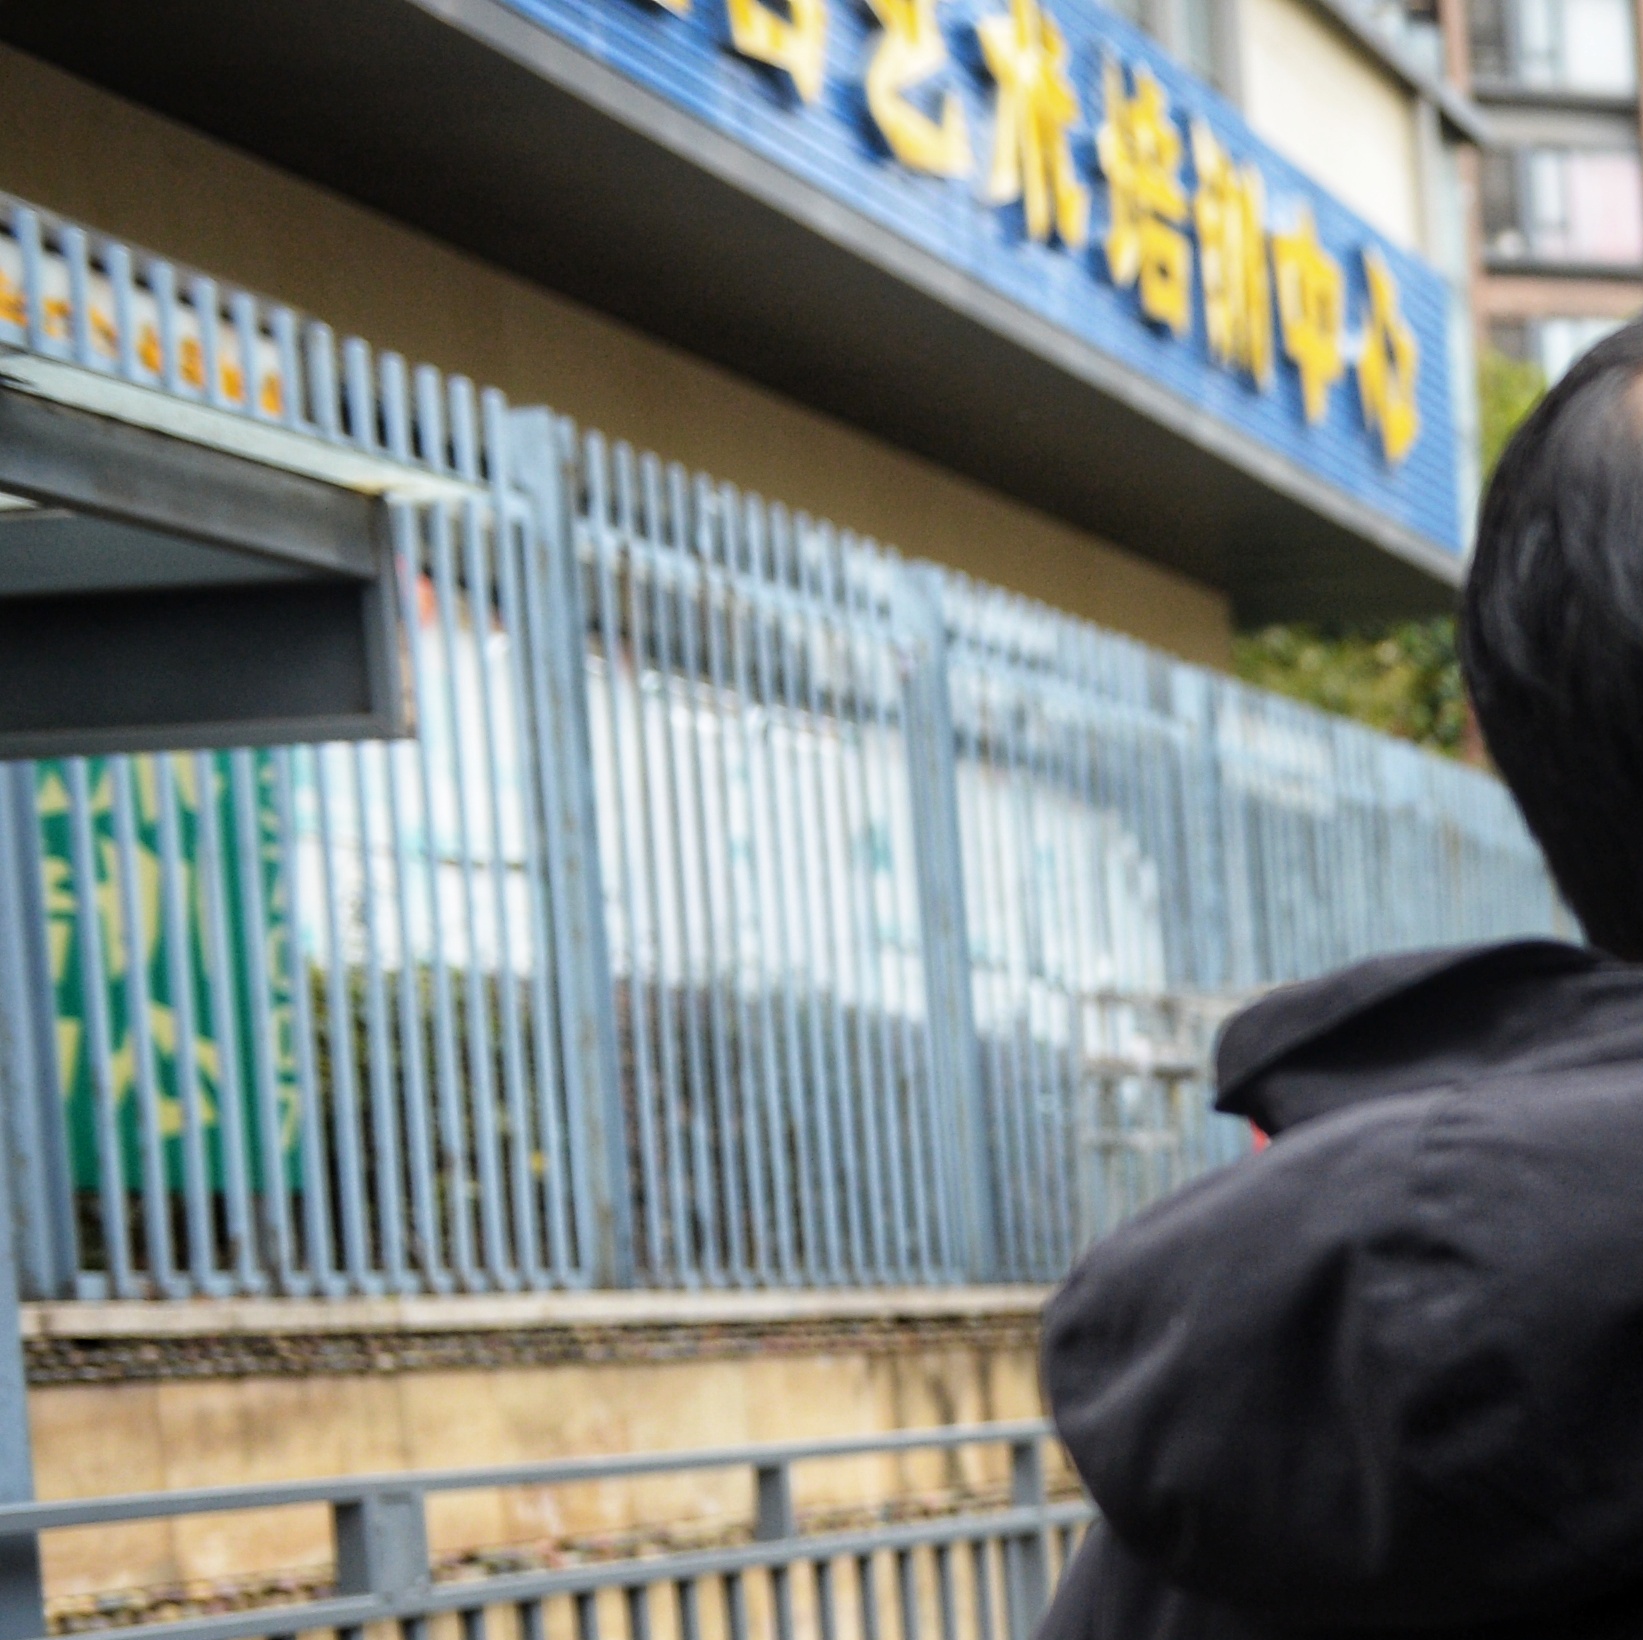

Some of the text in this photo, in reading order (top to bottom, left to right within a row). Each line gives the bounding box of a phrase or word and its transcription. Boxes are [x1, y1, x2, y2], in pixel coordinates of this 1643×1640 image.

[652, 0, 1422, 466] 艺术培训中心
